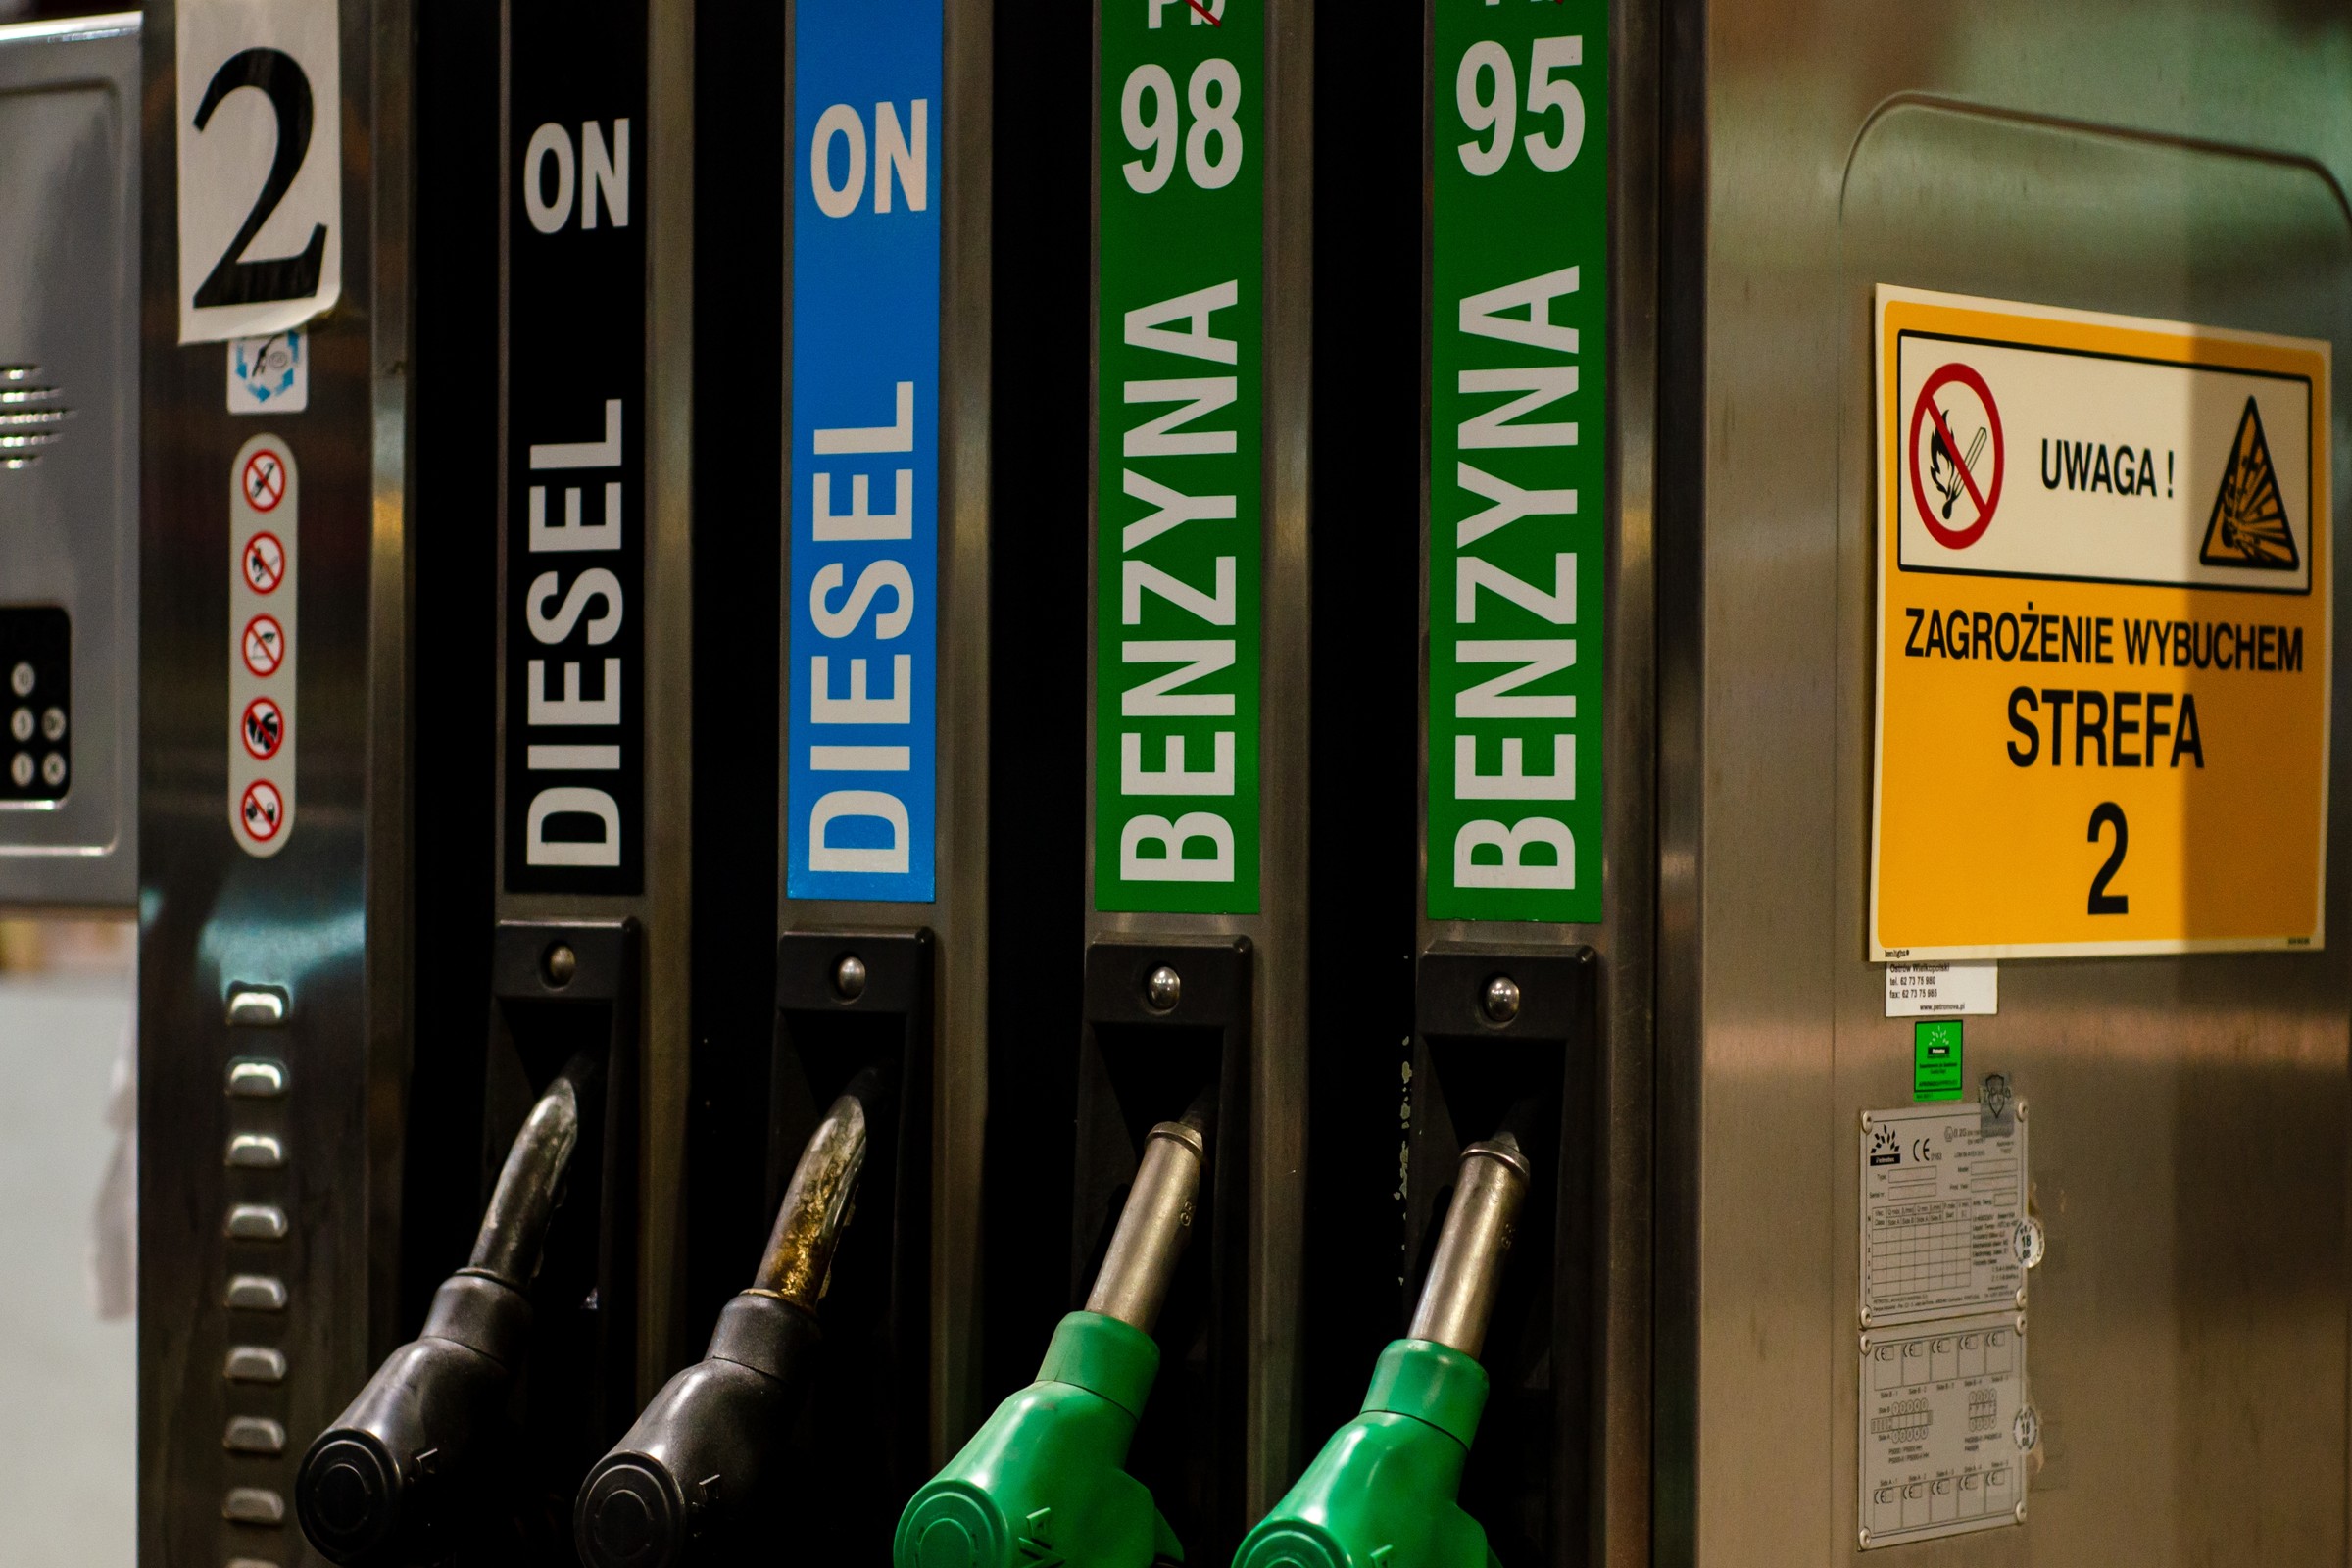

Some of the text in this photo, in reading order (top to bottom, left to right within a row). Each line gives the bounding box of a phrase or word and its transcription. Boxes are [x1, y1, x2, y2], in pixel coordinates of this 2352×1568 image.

[811, 98, 928, 218] ON
[1121, 58, 1243, 194] 98
[1456, 35, 1586, 176] 95
[193, 47, 327, 309] 2
[524, 118, 629, 233] ON
[2041, 438, 2158, 498] UWAGA
[526, 399, 624, 866] DIESEL
[808, 381, 914, 873] DIESEL
[1120, 279, 1238, 882] BENZYNA
[1454, 265, 1580, 890] BENZYNA
[1905, 602, 2304, 673] ZAGROŻENIE WYBUCHEM
[2007, 686, 2205, 769] STREFA
[2087, 801, 2129, 915] 2
